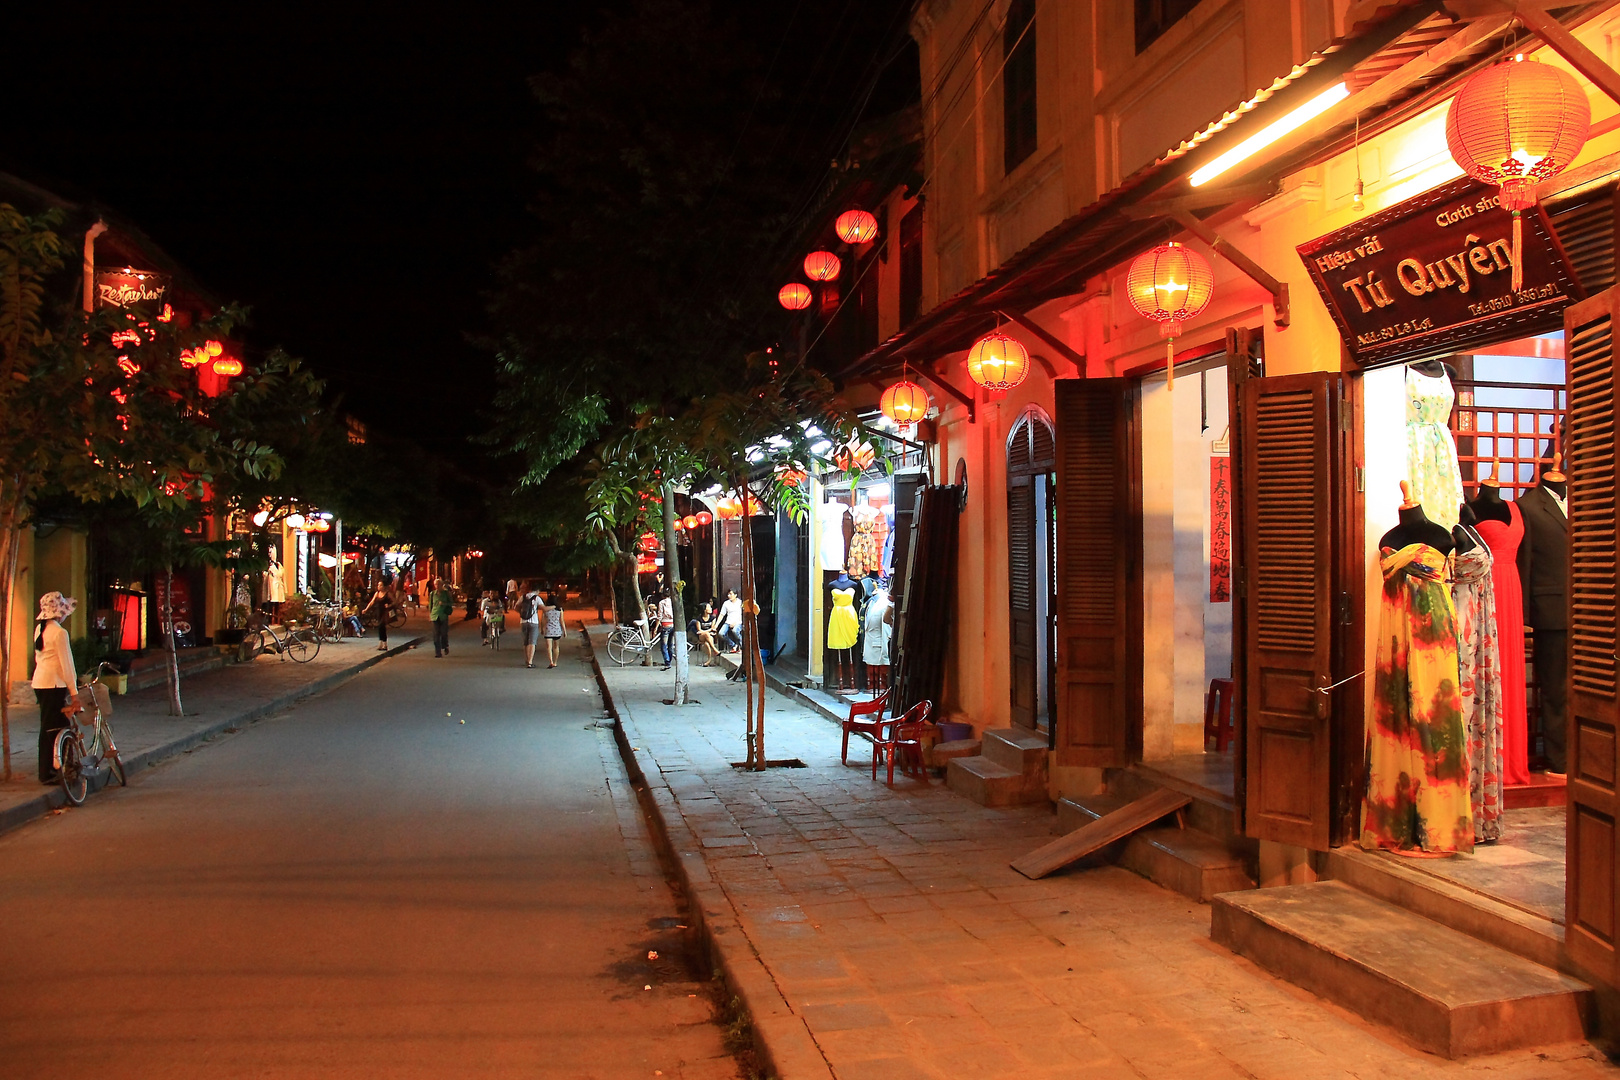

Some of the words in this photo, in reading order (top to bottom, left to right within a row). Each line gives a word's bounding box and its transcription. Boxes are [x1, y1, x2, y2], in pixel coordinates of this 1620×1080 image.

[1436, 204, 1475, 228] Cloth
[1476, 194, 1501, 213] sho
[1315, 251, 1356, 273] Hiệu
[1354, 235, 1385, 258] vải
[1342, 270, 1395, 314] Tú
[1396, 233, 1514, 297] Quyên
[98, 284, 166, 309] Restaurant
